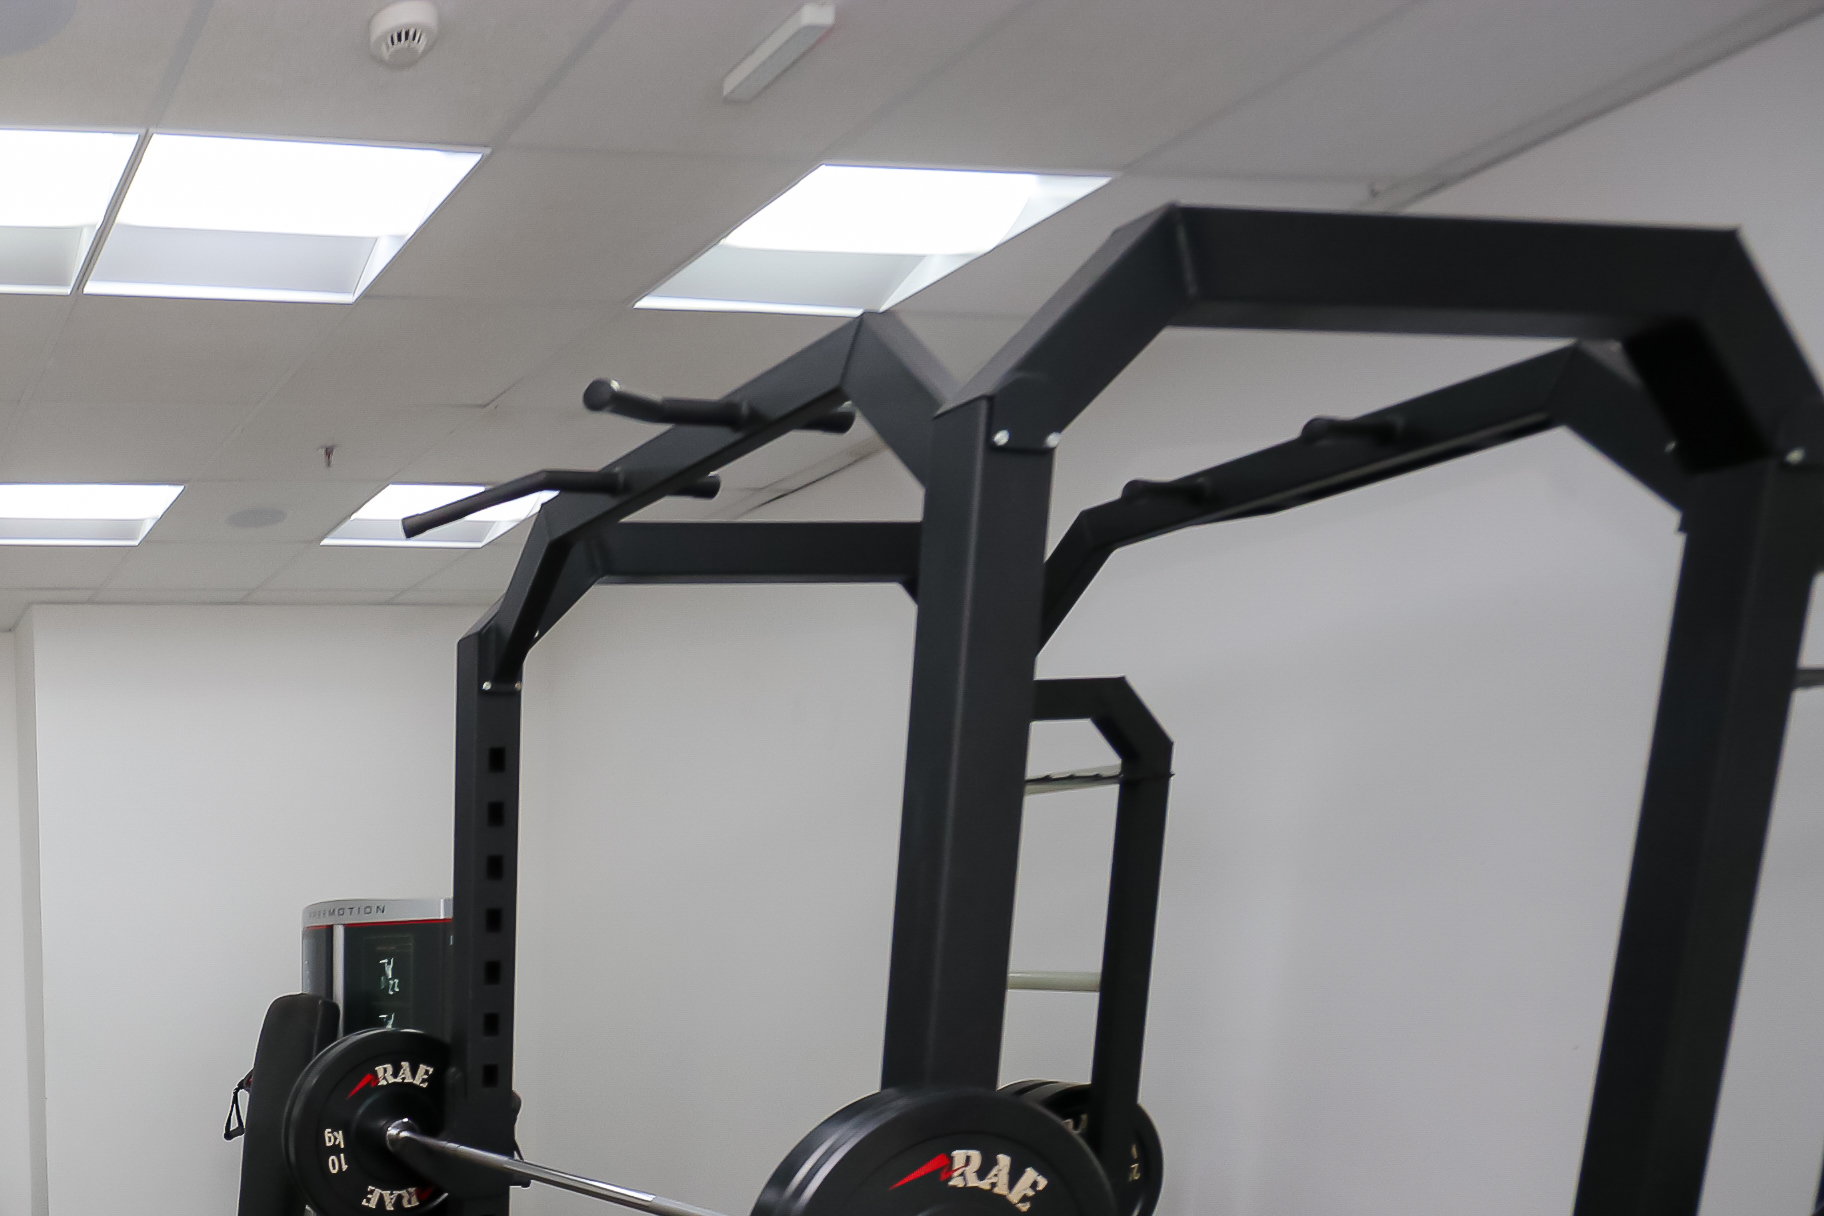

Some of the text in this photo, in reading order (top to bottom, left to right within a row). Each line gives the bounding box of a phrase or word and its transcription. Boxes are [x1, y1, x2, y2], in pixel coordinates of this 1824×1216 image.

[374, 1061, 434, 1088] RAE
[324, 1128, 345, 1149] kg
[328, 1153, 349, 1174] 10
[948, 1149, 1049, 1212] RAE
[361, 1185, 420, 1211] RAE
